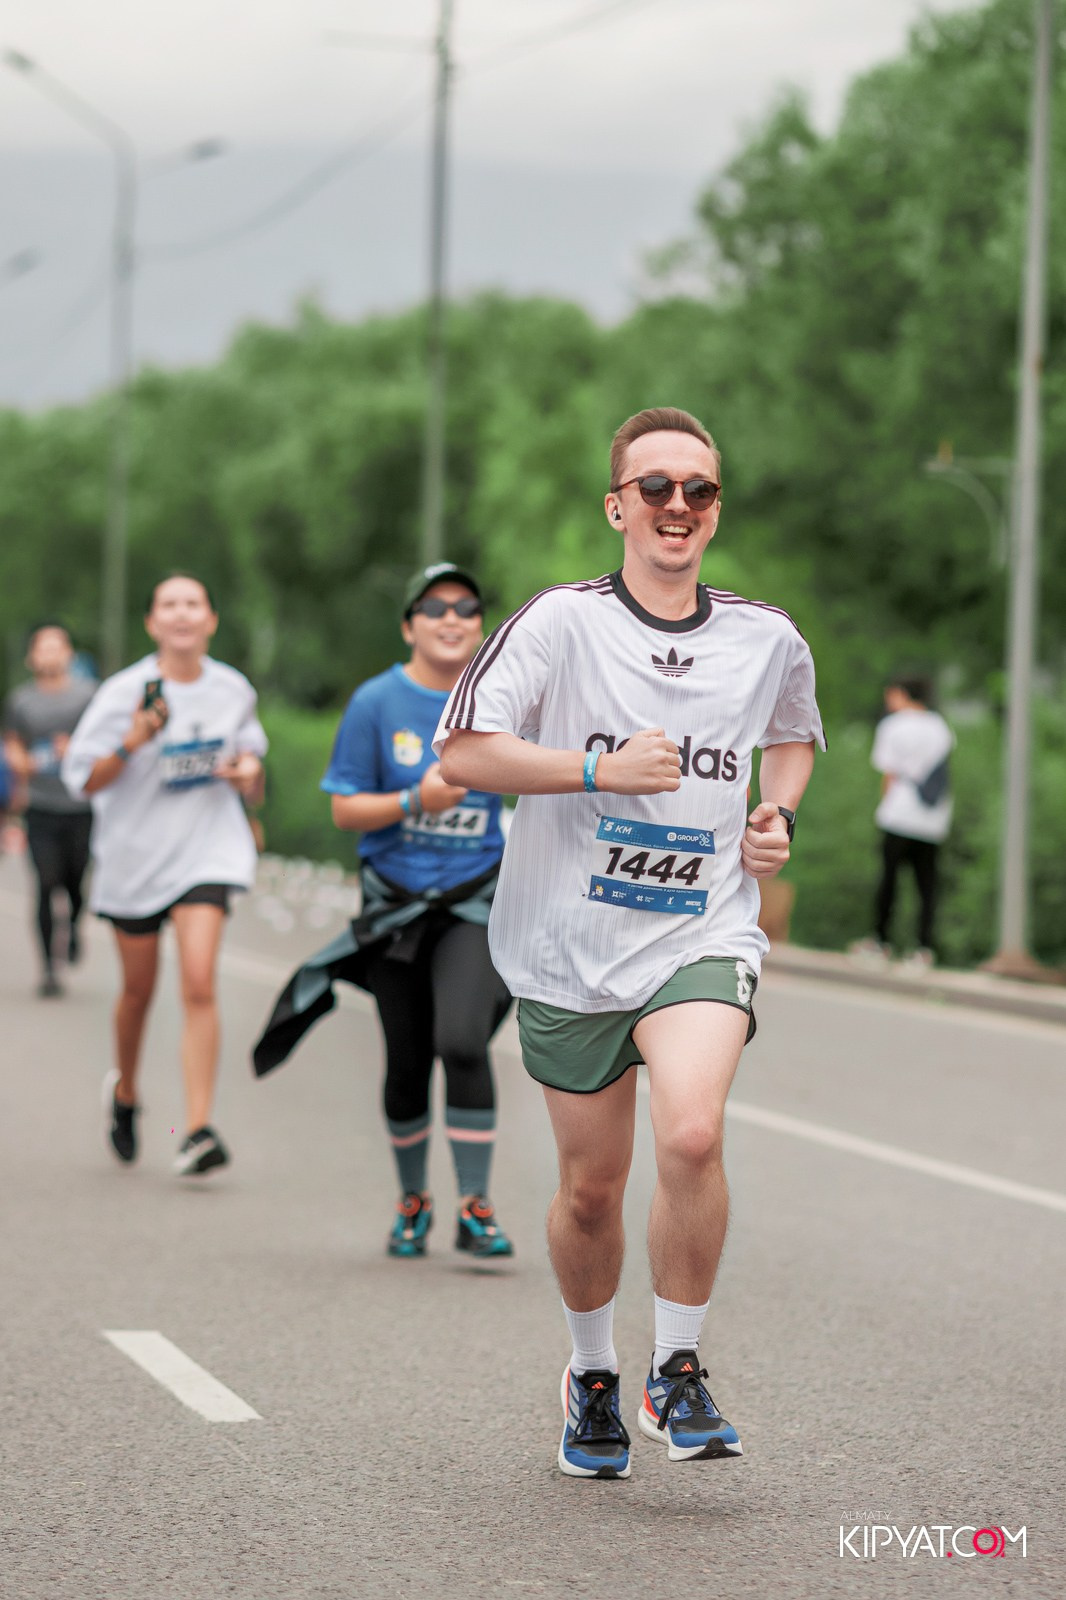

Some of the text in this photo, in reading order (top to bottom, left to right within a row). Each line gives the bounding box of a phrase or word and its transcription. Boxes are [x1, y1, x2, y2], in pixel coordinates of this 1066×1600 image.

[585, 732, 737, 782] adas
[603, 821, 632, 835] 5 KM
[677, 834, 699, 843] GROUP
[605, 847, 704, 886] 1444
